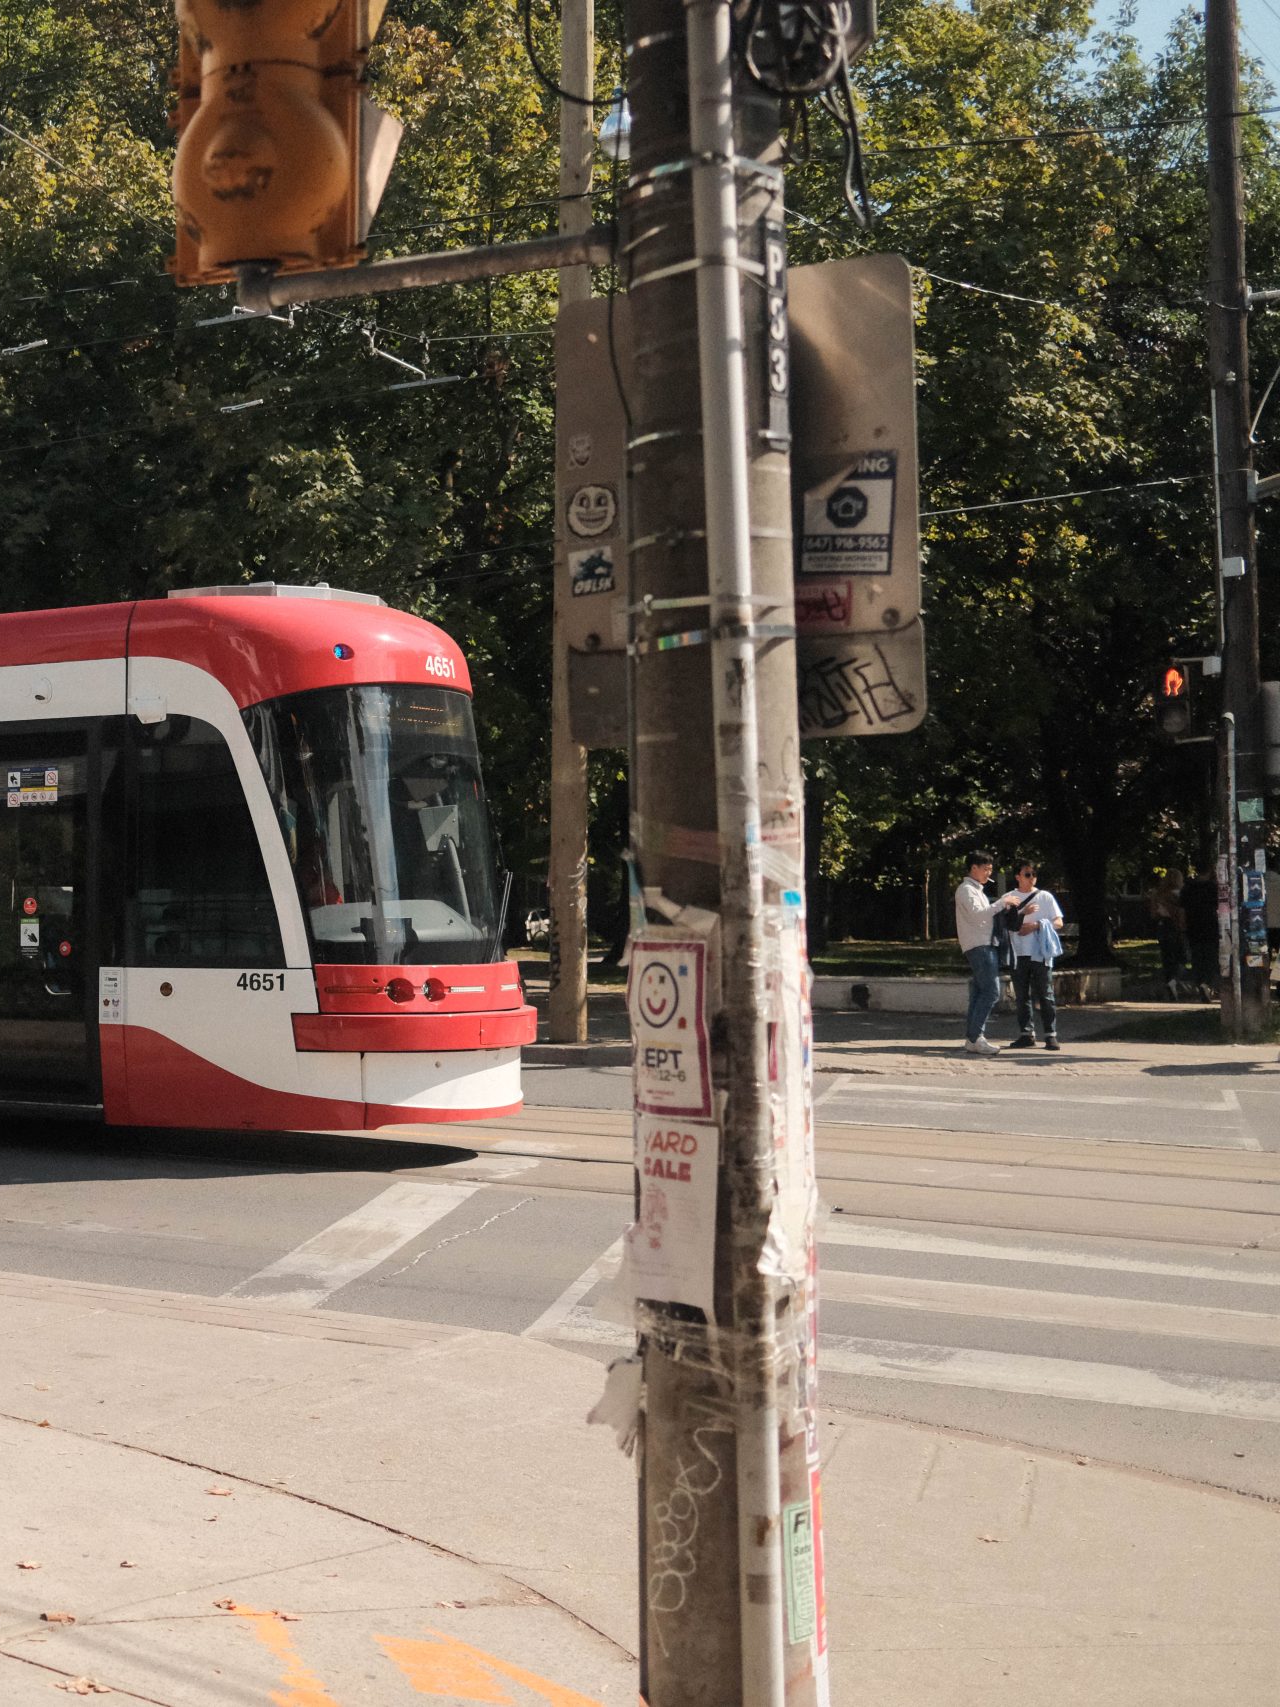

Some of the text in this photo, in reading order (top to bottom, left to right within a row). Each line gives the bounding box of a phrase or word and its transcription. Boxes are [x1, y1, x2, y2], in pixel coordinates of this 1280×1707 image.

[425, 655, 456, 679] 4651
[236, 972, 285, 991] 4651
[641, 1047, 683, 1069] EPT
[644, 1130, 698, 1156] YARD
[644, 1157, 691, 1182] SALE
